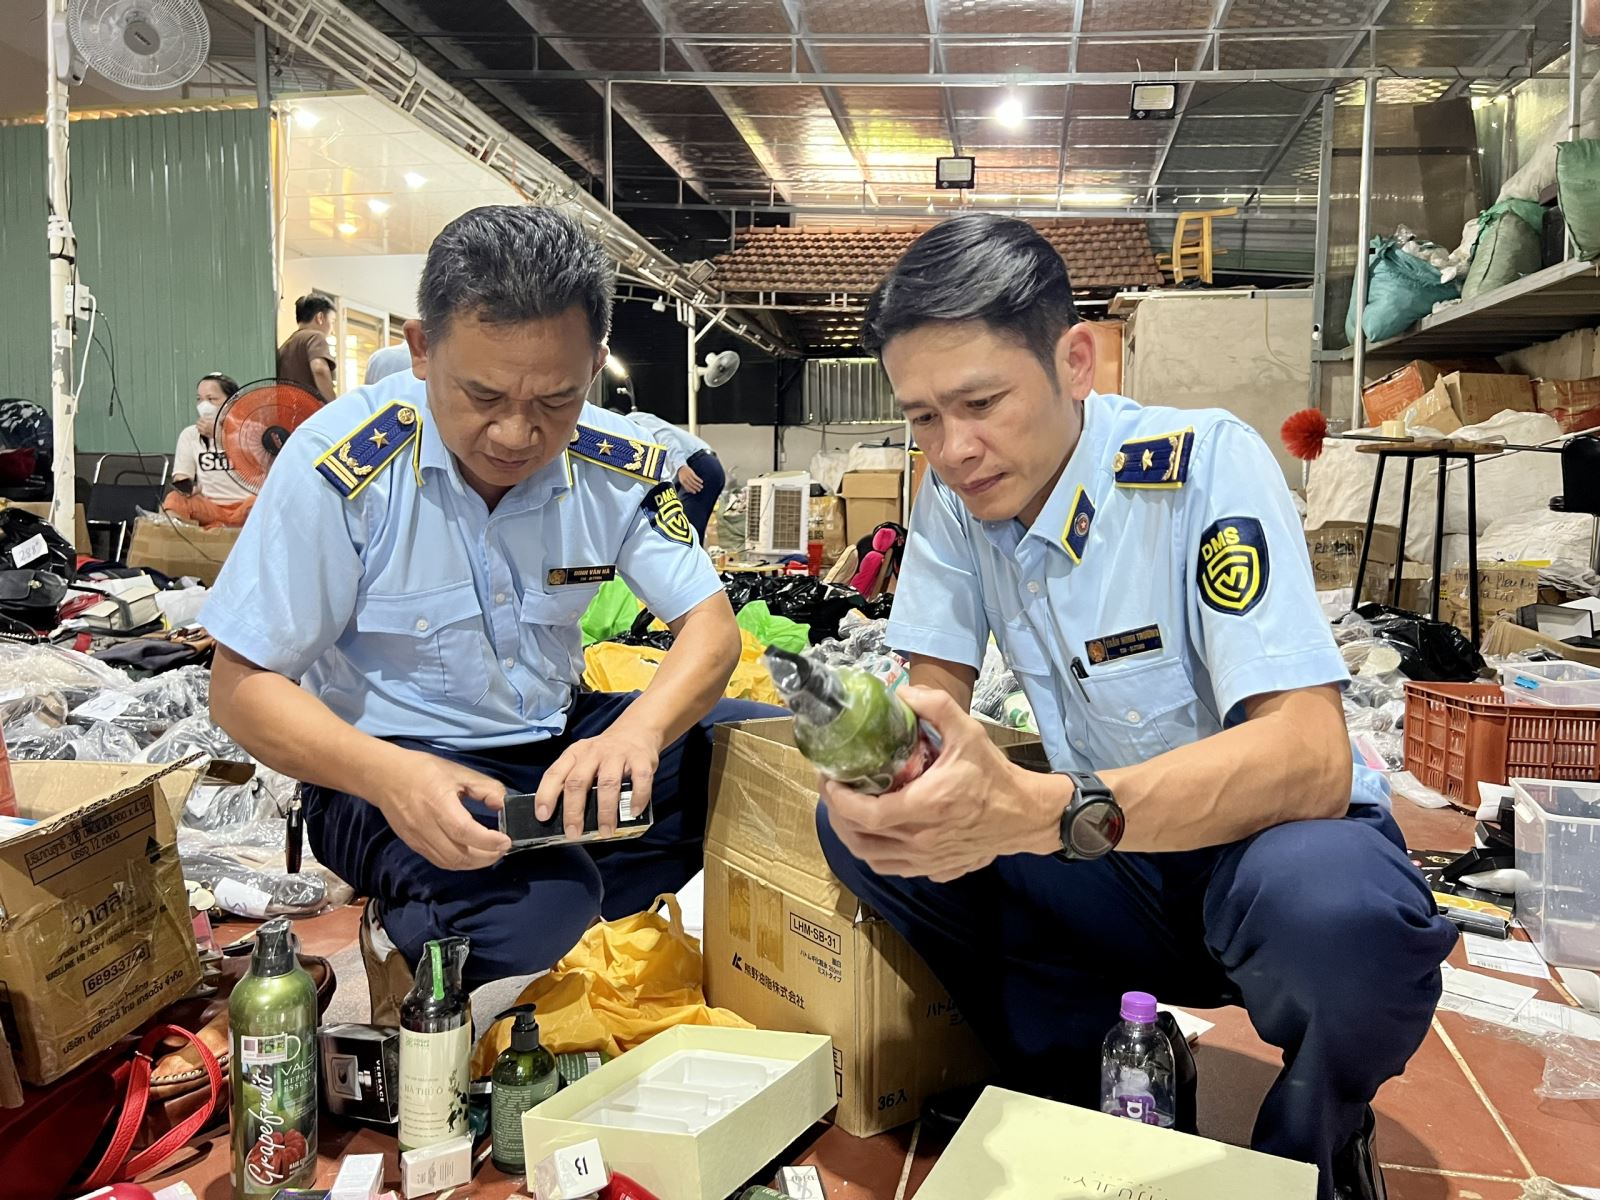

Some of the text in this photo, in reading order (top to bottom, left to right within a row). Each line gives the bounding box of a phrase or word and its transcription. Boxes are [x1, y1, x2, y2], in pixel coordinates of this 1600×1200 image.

[654, 488, 679, 505] DMS
[1202, 526, 1240, 561] DMS
[91, 838, 100, 851] 12
[793, 918, 836, 949] LHM-SB-31
[376, 1059, 385, 1103] VERSACE
[248, 1067, 286, 1185] Grapefruit
